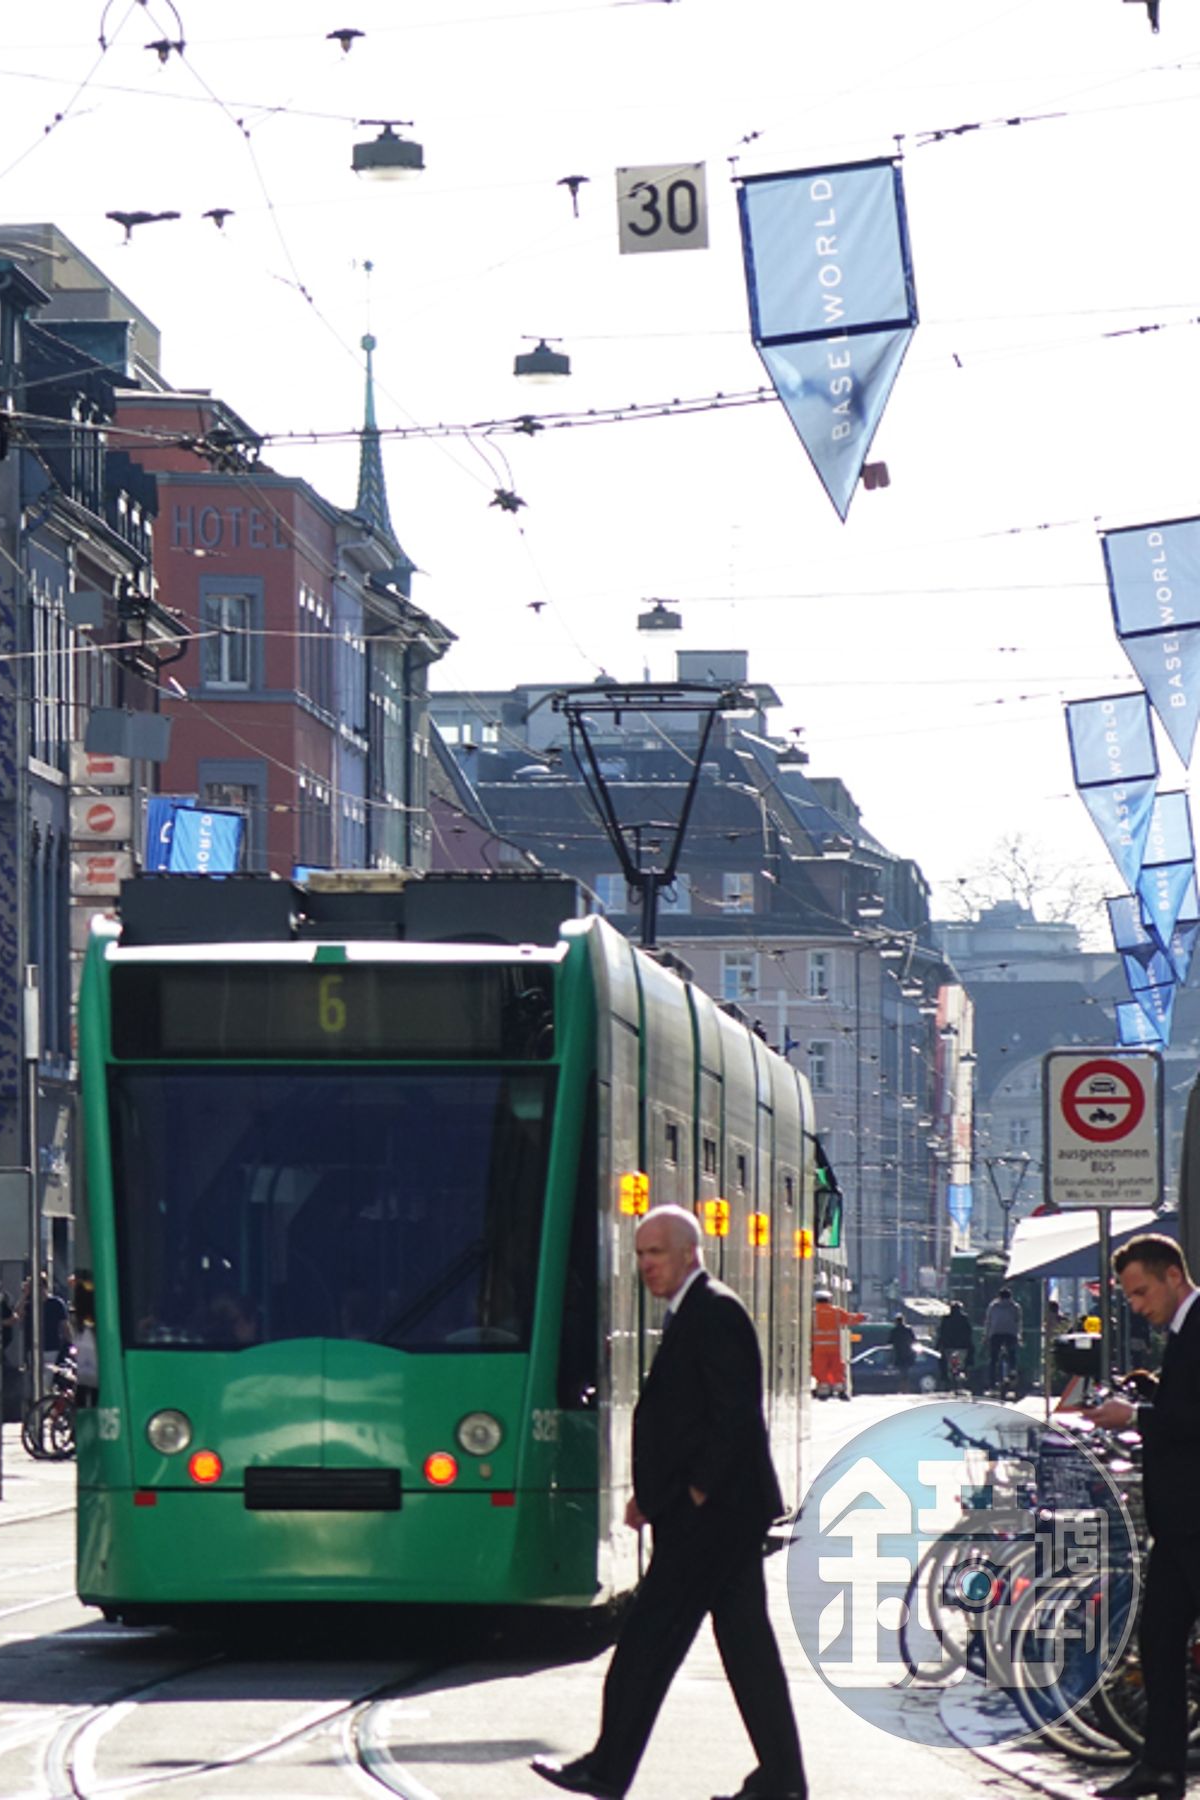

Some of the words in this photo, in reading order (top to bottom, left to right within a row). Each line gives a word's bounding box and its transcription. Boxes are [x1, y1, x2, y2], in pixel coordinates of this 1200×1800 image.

[628, 179, 699, 237] 30
[171, 504, 289, 549] HOTEL
[1101, 701, 1133, 845] BASEWORLD
[320, 974, 347, 1034] 6
[1090, 1161, 1117, 1173] BUS
